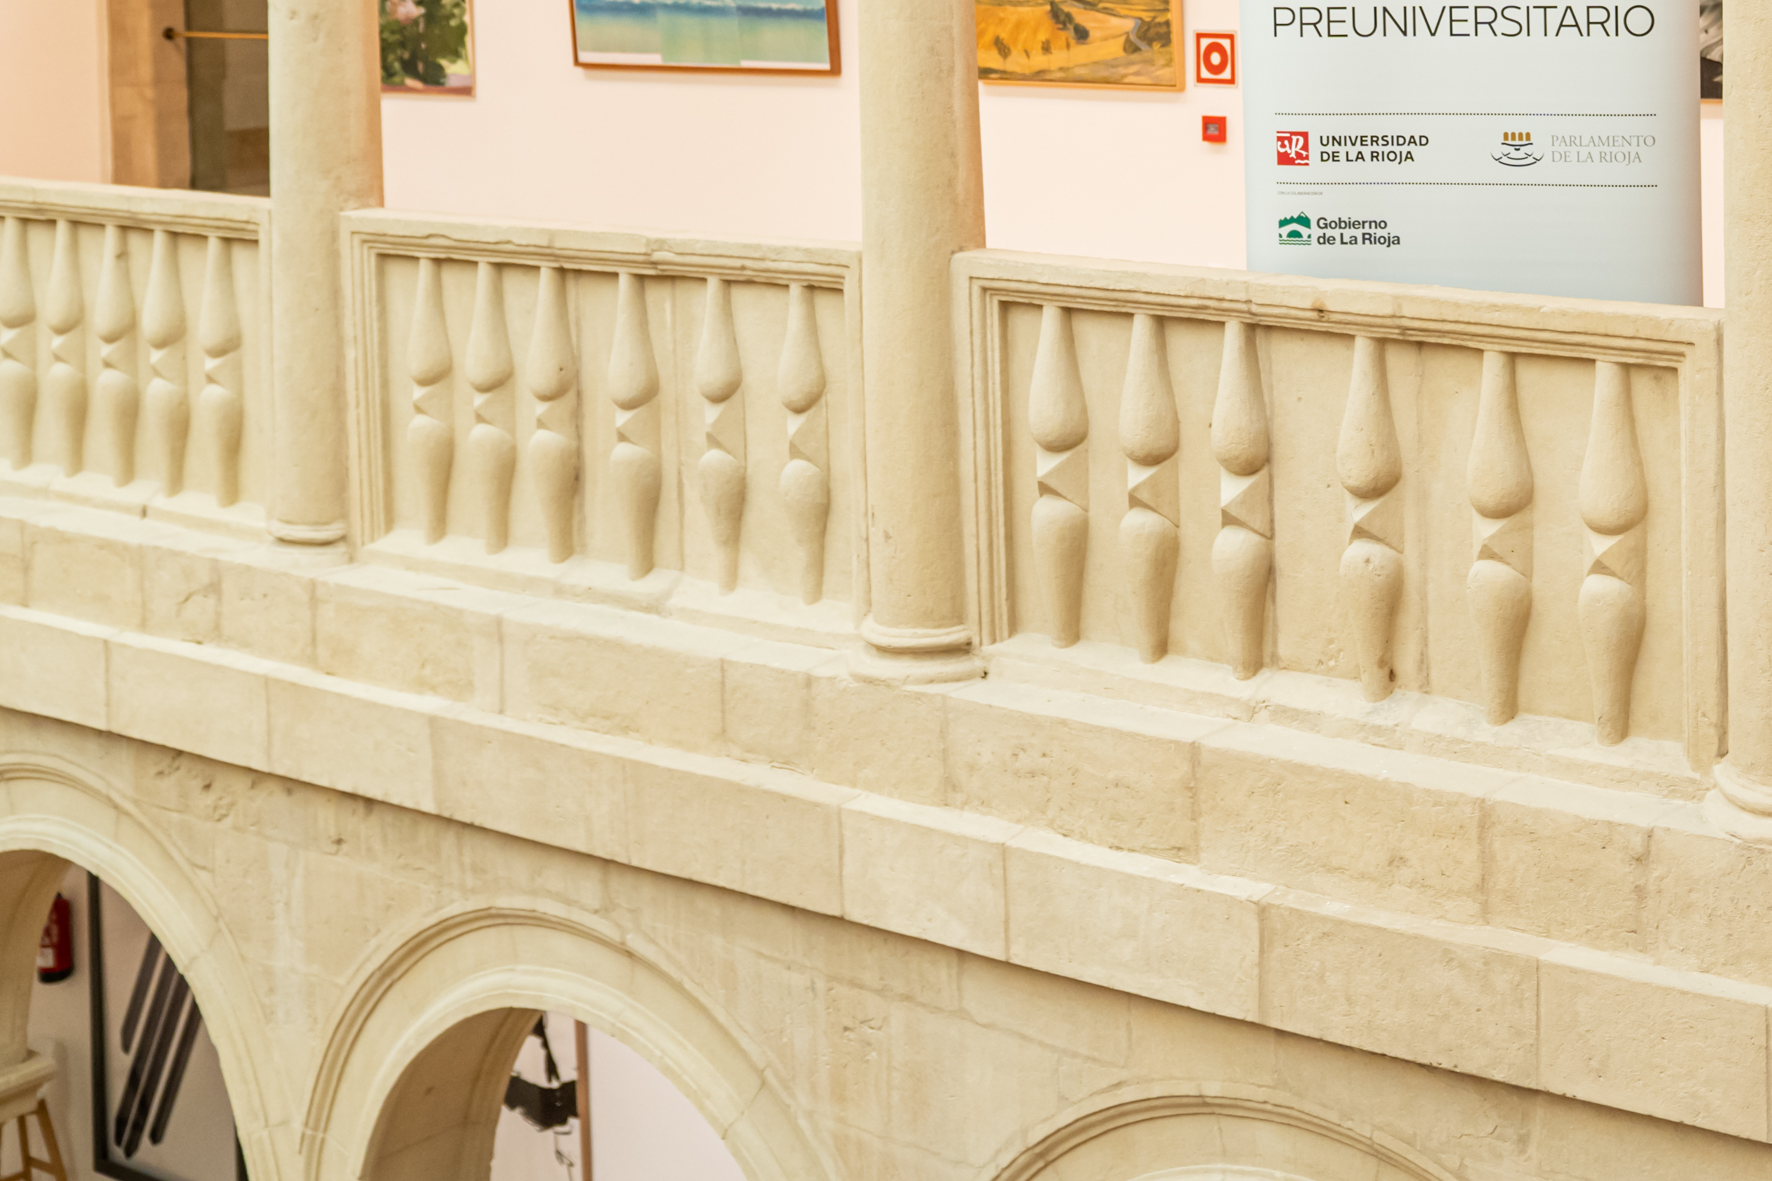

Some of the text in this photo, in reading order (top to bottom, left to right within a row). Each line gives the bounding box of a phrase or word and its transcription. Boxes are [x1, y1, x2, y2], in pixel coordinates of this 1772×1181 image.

[1273, 4, 1656, 38] PREUNIVERSITARIO
[1319, 135, 1430, 147] UNIVERSIDAD
[1551, 134, 1656, 147] PARLAMENTO
[1320, 150, 1415, 165] DE LA RIOJA
[1551, 150, 1642, 167] DE LA RIOJA
[1316, 217, 1388, 230] Gobierno
[1317, 232, 1401, 248] de La Rioja
